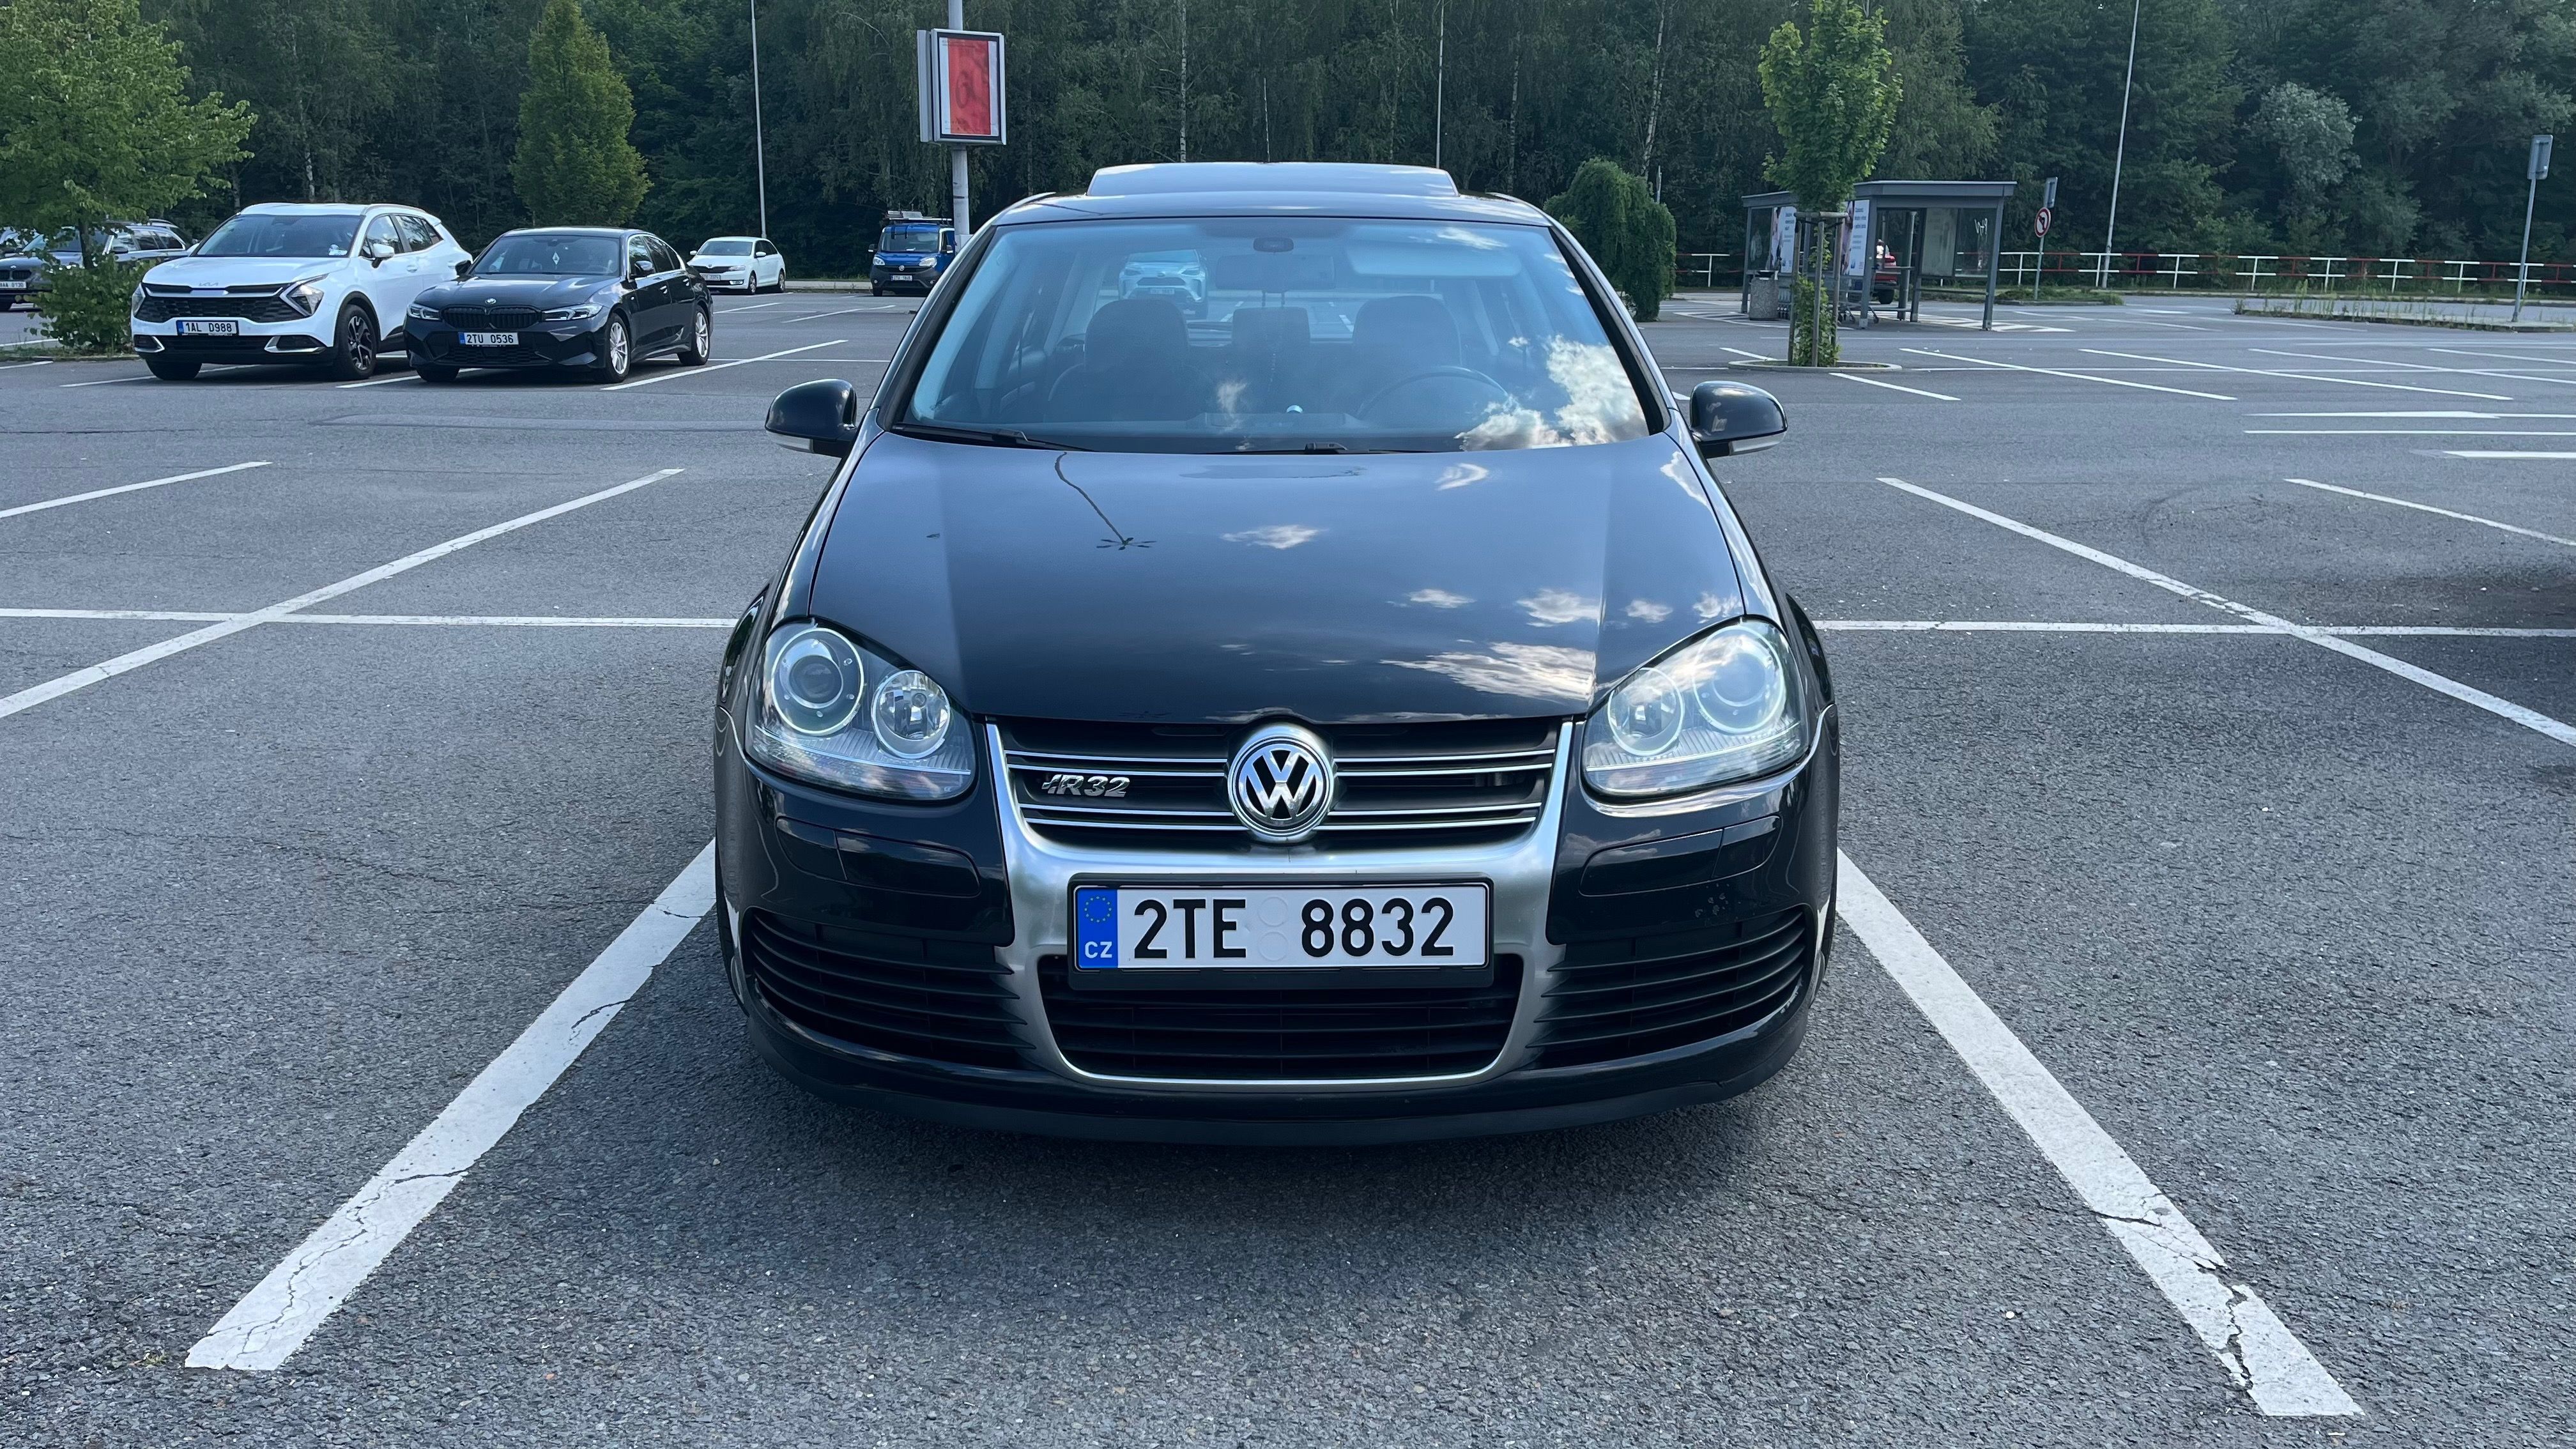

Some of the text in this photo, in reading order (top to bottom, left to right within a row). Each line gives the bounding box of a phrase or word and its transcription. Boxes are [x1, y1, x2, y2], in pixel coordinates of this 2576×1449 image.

[185, 323, 232, 332] 1AL D988
[466, 334, 514, 344] 2TU 0536
[1042, 774, 1130, 797] R32
[1239, 744, 1324, 825] VW
[1134, 897, 1454, 959] 2TE 8832
[1085, 940, 1112, 958] CZ
